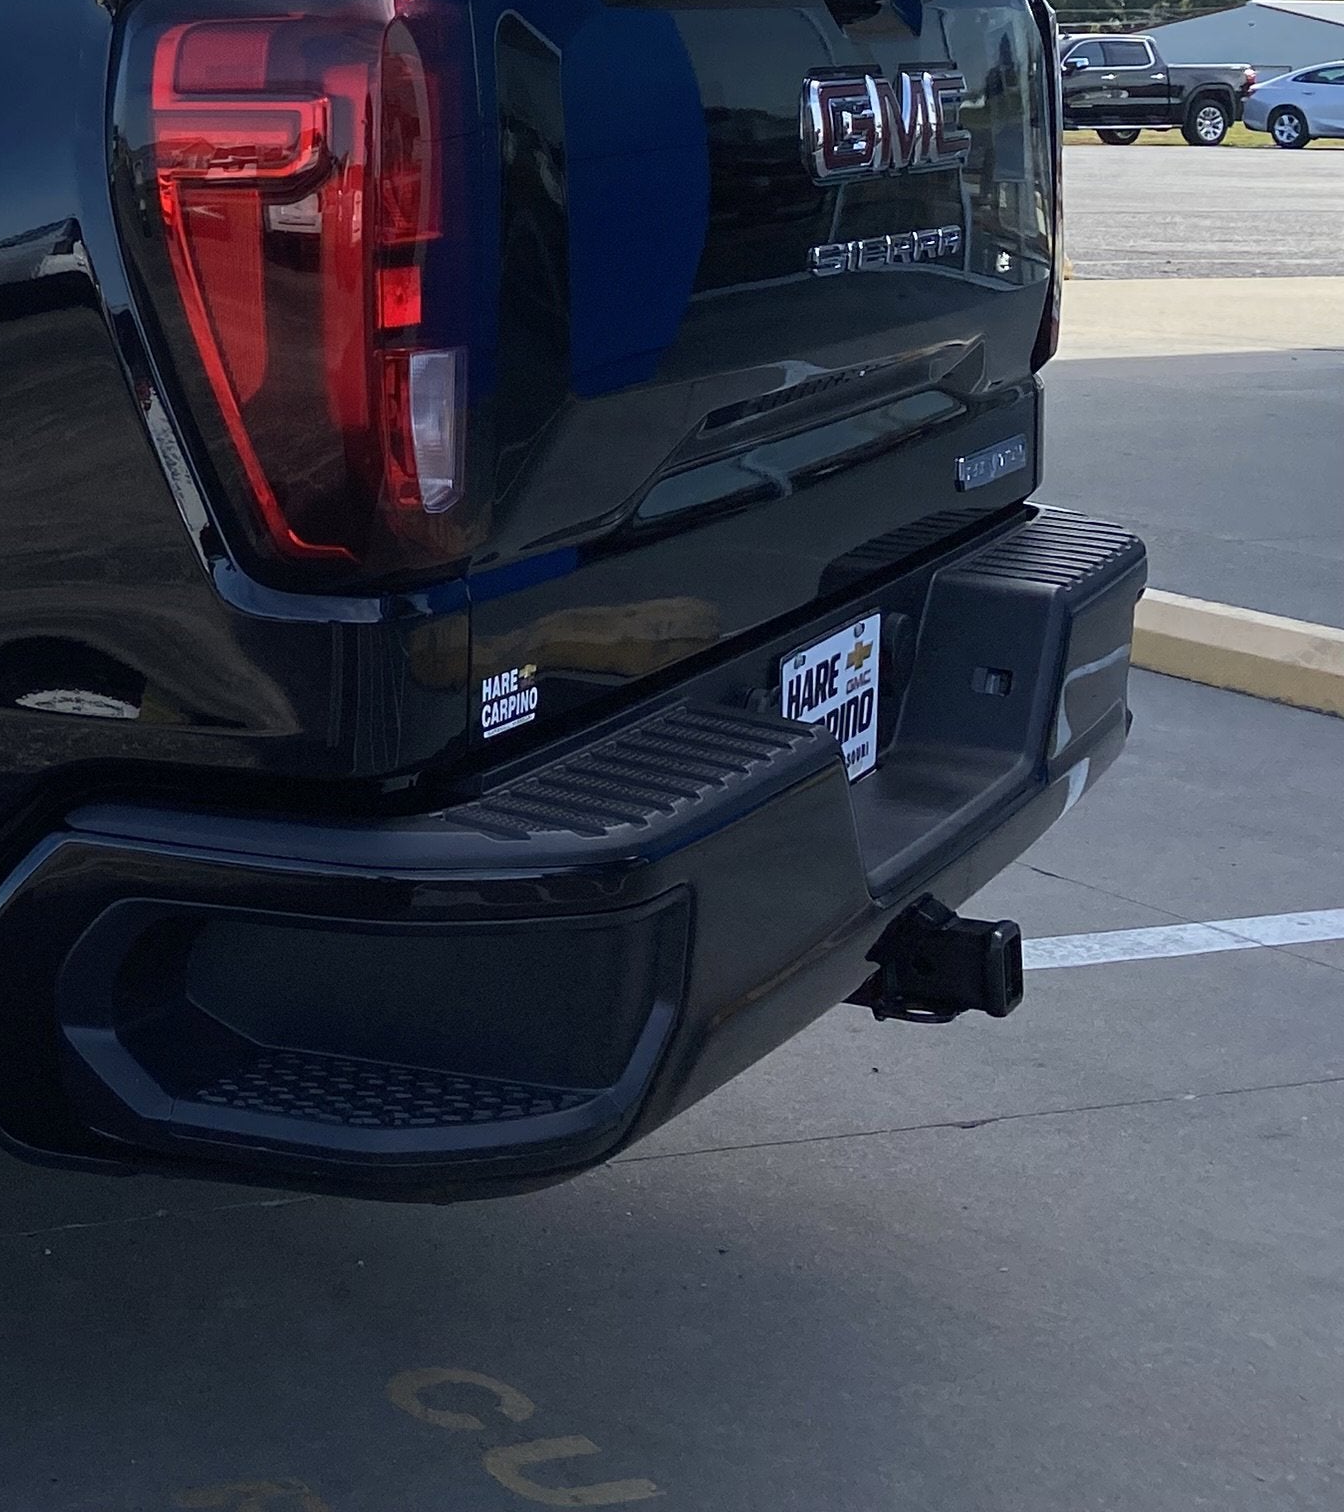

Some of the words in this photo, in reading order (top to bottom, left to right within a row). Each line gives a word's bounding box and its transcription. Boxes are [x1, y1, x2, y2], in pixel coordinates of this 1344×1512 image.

[801, 66, 971, 180] GMC
[809, 225, 961, 277] SIERRA
[483, 669, 518, 702] HARE
[788, 652, 841, 720] HARE
[846, 670, 871, 695] GMC
[482, 687, 537, 727] CARPINO
[814, 687, 875, 744] PINO
[846, 742, 869, 767] SOURI
